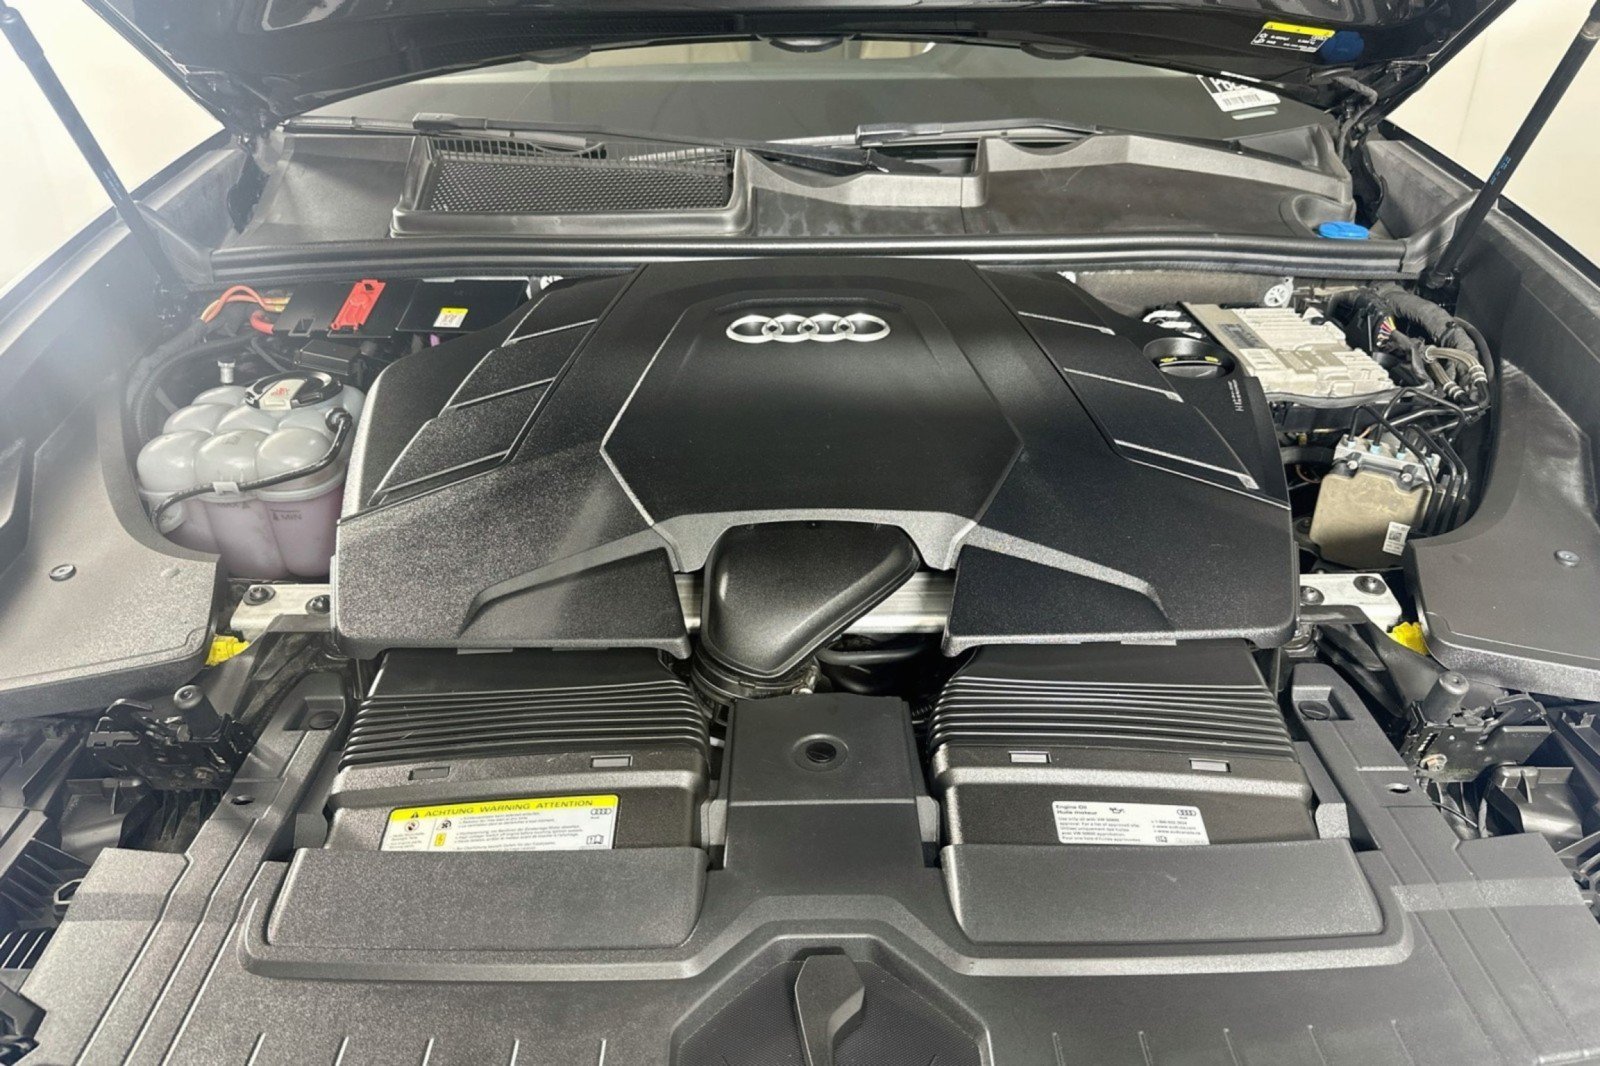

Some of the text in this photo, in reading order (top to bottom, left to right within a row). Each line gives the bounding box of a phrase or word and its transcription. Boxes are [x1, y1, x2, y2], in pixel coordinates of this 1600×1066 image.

[424, 808, 474, 817] ACHTUNG
[480, 803, 530, 812] WARNING
[536, 800, 593, 808] ATTENTION
